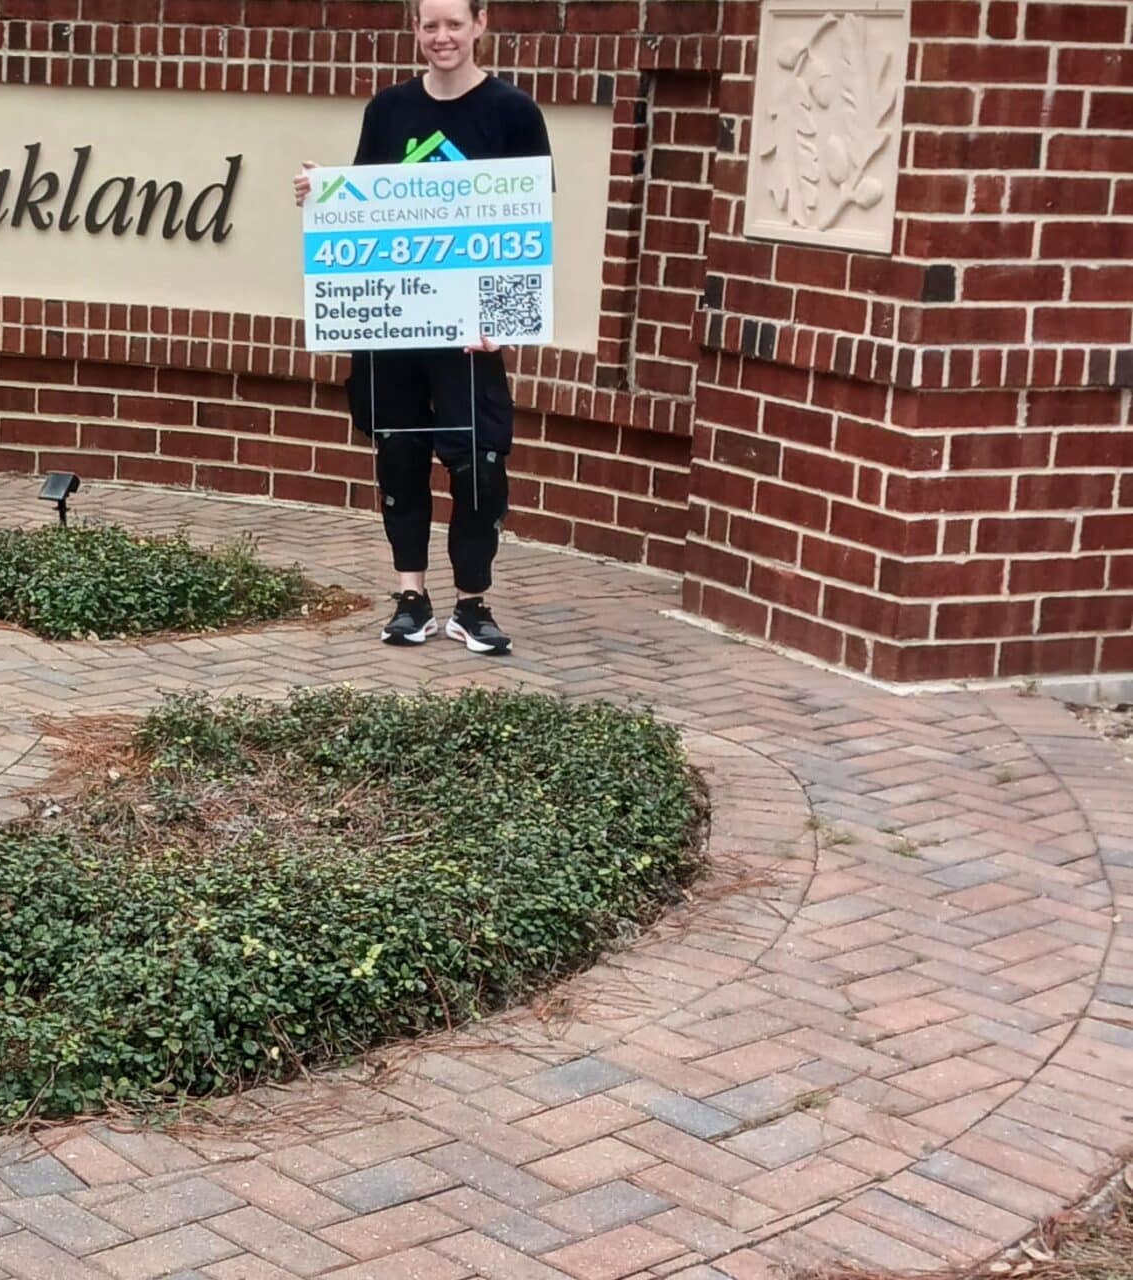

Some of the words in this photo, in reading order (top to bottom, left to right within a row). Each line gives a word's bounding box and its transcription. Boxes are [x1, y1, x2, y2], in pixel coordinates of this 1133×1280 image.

[373, 172, 535, 203] CottageCare
[314, 210, 365, 226] HOUSE
[370, 206, 449, 223] CLEANING
[455, 205, 471, 218] AT
[476, 204, 497, 218] ITS
[503, 202, 542, 217] BEST!
[314, 230, 544, 267] 407-877-0135
[315, 278, 396, 301] Simplify
[401, 276, 438, 295] life.
[315, 301, 403, 323] Delegate
